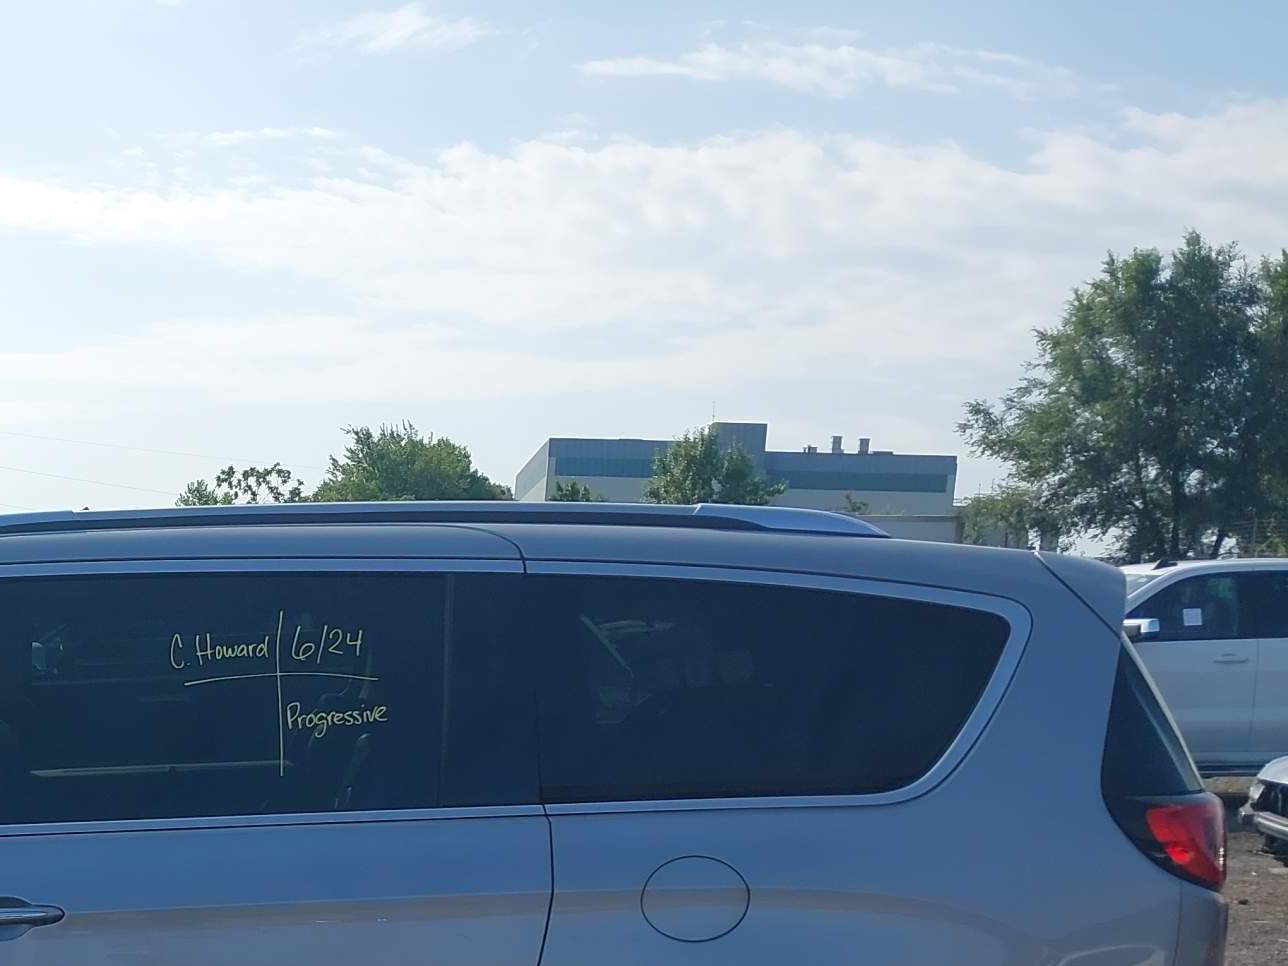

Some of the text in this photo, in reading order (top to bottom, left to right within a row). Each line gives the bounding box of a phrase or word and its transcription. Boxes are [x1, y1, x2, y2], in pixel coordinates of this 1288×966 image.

[169, 632, 270, 670] C. Howard
[290, 624, 364, 665] 6/24
[285, 702, 388, 738] Progressive
